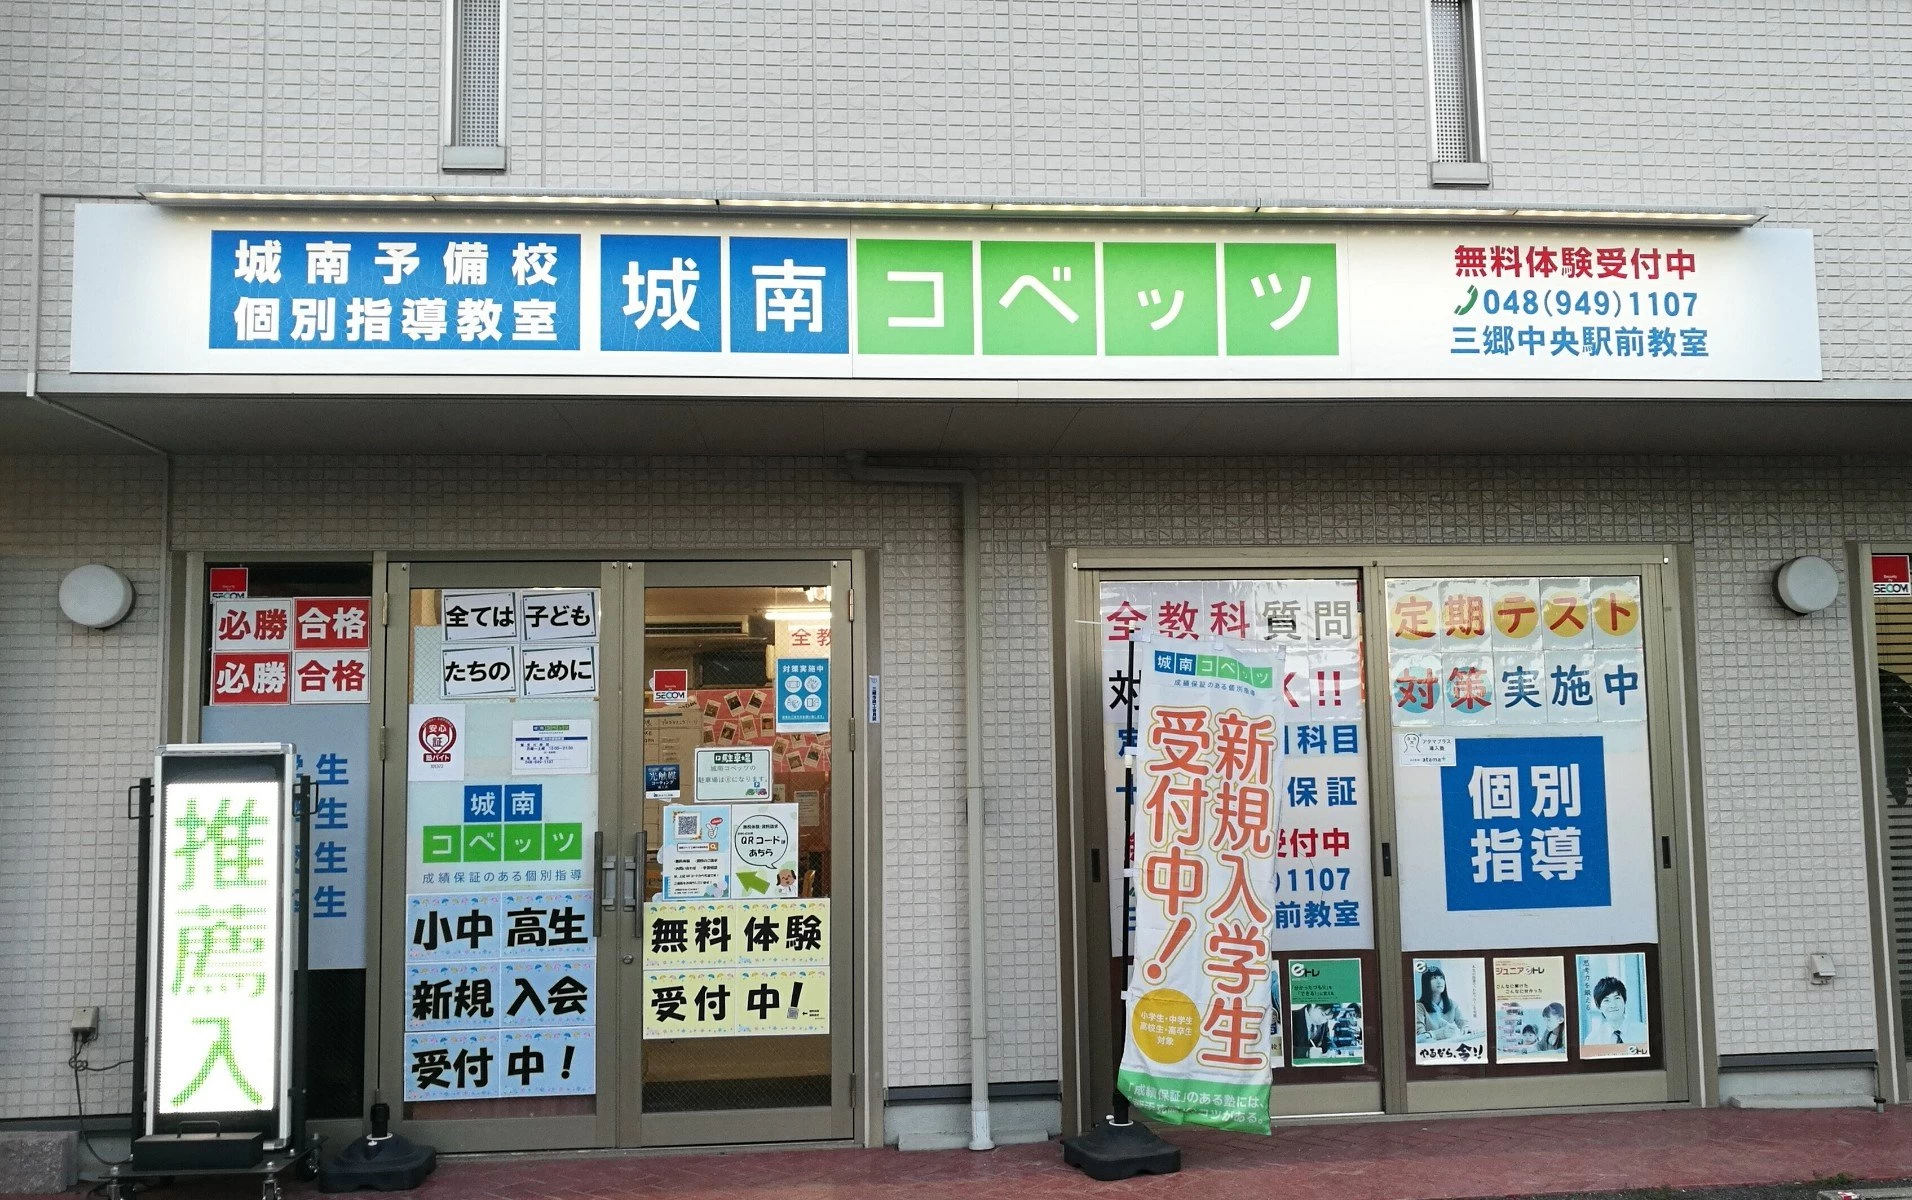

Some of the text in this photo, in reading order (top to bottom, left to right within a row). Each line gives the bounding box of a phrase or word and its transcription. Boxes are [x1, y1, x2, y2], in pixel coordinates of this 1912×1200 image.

[234, 239, 558, 285] 城南予備校
[1454, 245, 1696, 280] 無料体験受付中
[623, 258, 1311, 332] 城南コベッツ
[1483, 289, 1698, 318] 048(949)1107
[234, 297, 558, 342] 個別指導教室
[1450, 326, 1709, 357] 三郷中央駅前教室
[1874, 584, 1908, 592] SECOM
[218, 607, 366, 640] 必勝 合格
[446, 605, 590, 628] 全ては 子ども
[1106, 600, 1351, 641] 全教科質問
[1395, 592, 1630, 638] 定期テスト
[216, 660, 365, 694] 必勝 合格
[445, 660, 592, 682] たちの ために
[1157, 655, 1269, 684] 城南コベッツ
[655, 691, 685, 699] SECOM
[1396, 664, 1638, 710] 対策実施中
[1284, 724, 1358, 754] 科目
[471, 791, 535, 816] 城南
[1287, 776, 1357, 807] 保証
[1468, 764, 1581, 820] 個別
[432, 832, 573, 854] コベッツ
[1146, 710, 1210, 980] 受付中!
[1470, 826, 1583, 883] 指導
[422, 869, 582, 884] 成績保証のある個別指導
[1202, 712, 1275, 1065] 新規入学生
[651, 915, 822, 954] 無料体験
[170, 796, 271, 1108] 推薦入
[1157, 1036, 1174, 1047] 対象
